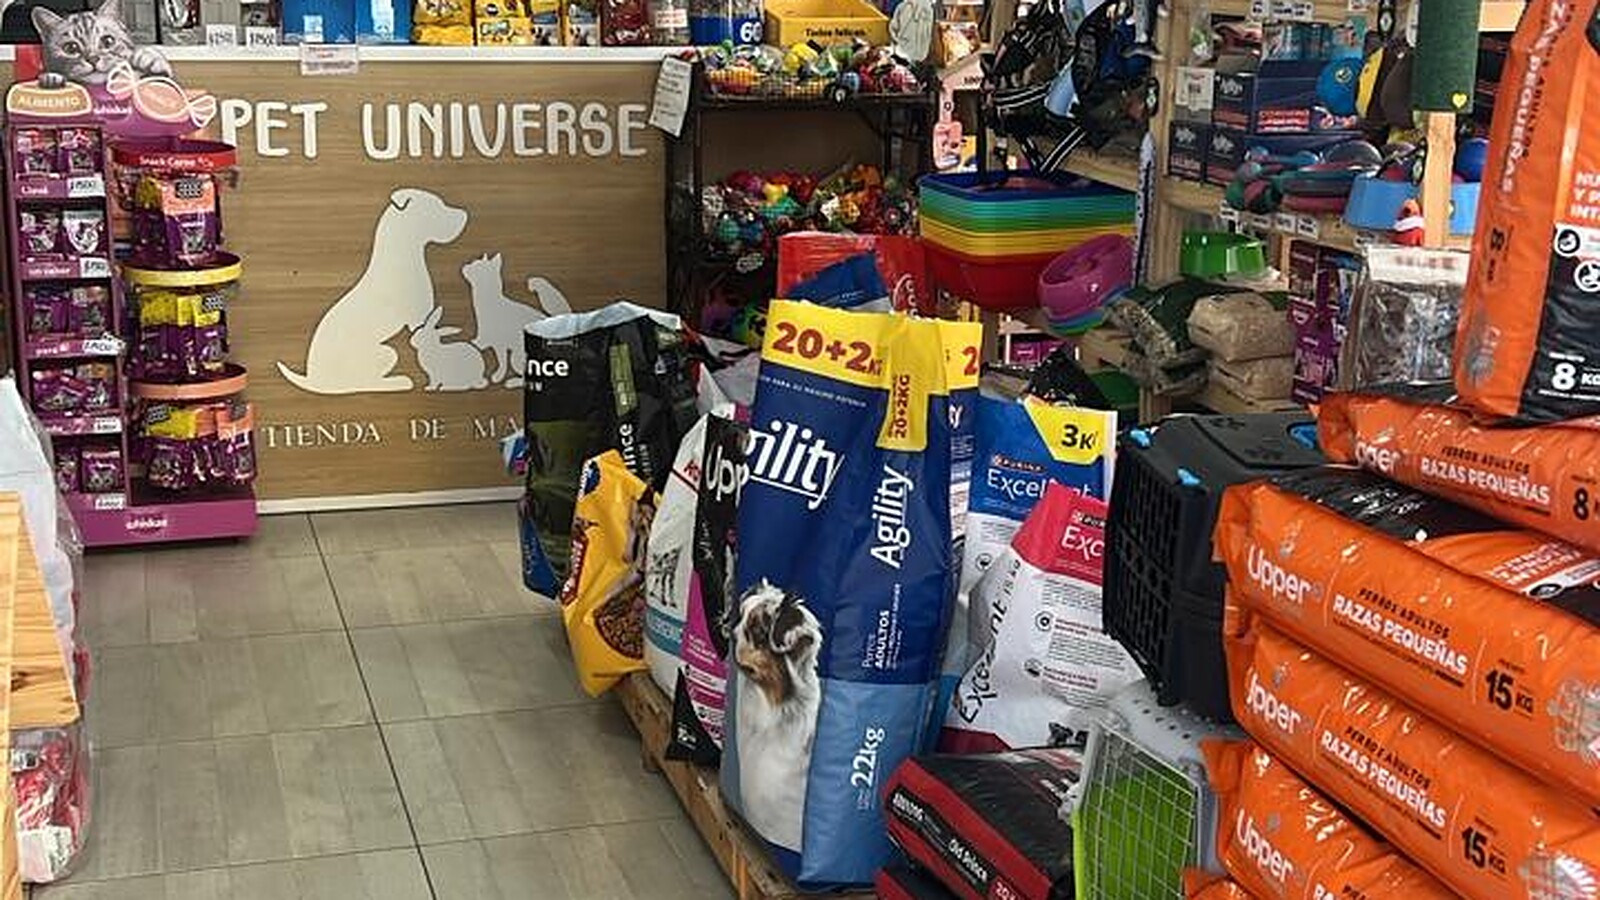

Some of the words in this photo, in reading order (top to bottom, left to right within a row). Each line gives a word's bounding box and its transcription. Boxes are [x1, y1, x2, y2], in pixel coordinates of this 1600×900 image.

[220, 99, 328, 159] PET
[361, 101, 648, 160] UNIVERSE
[1552, 362, 1576, 391] 8
[262, 422, 383, 448] TIENDA
[410, 417, 446, 441] DE
[1420, 457, 1466, 484] RAZAS
[1467, 470, 1551, 505] PEQUEÑAS
[1573, 487, 1590, 521] 8
[870, 464, 914, 569] Agility
[1247, 544, 1312, 604] Upper
[874, 609, 890, 671] ADULTOS
[1333, 594, 1382, 633] RAZAS
[1382, 619, 1470, 675] PEQUEÑAS
[1485, 670, 1514, 712] 15
[1515, 692, 1535, 714] KG
[851, 726, 885, 789] 22kg
[1321, 730, 1368, 774] RAZAS
[1367, 762, 1448, 830] PEQUEÑAS
[1236, 808, 1294, 884] Upper
[1461, 825, 1489, 870] 15
[1488, 850, 1507, 876] KG
